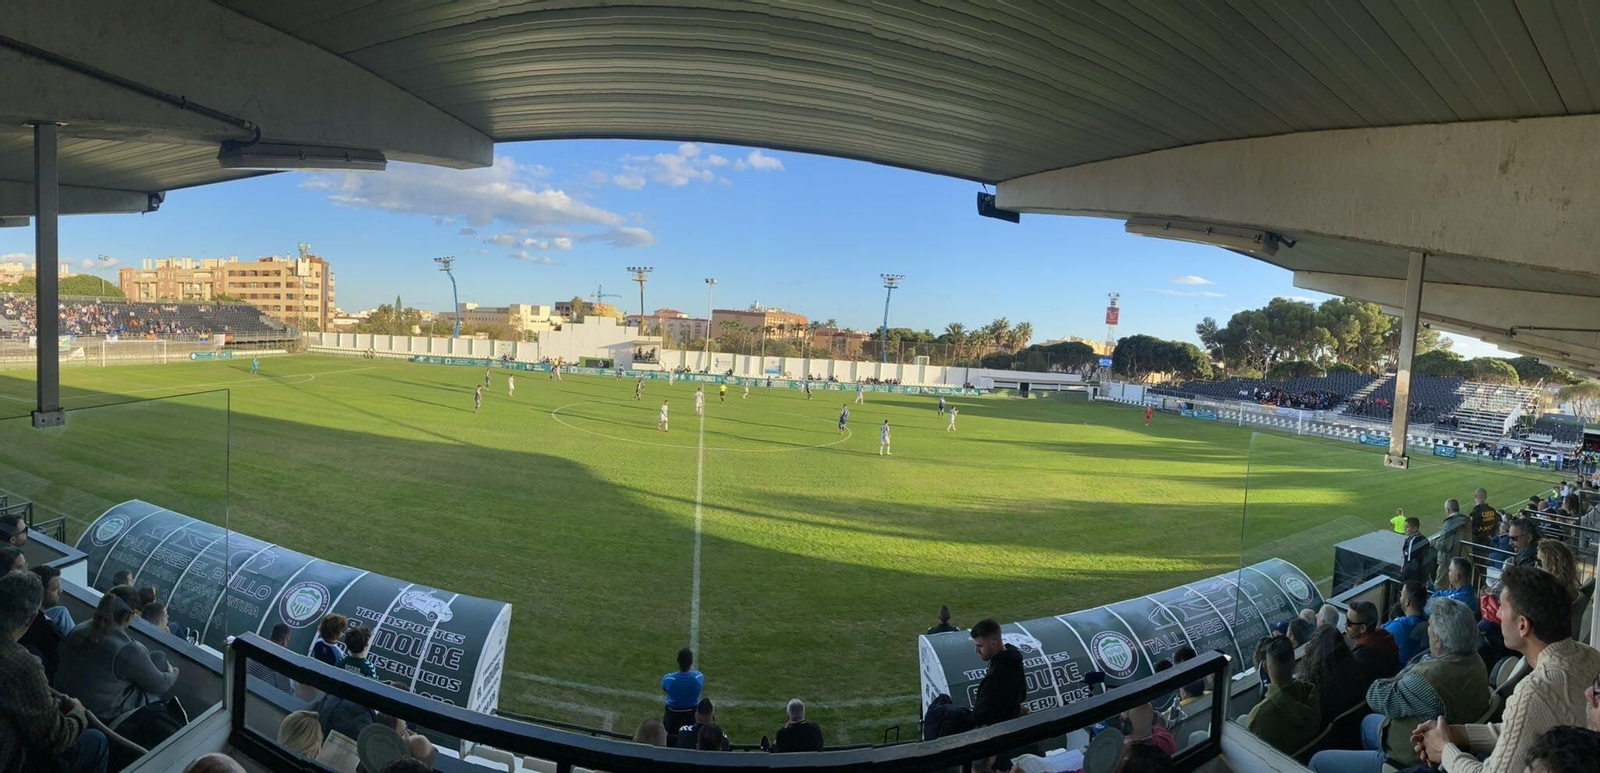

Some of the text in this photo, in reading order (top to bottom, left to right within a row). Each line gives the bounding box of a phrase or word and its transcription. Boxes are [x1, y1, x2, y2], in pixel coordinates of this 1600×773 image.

[121, 534, 191, 570] TALLERES
[189, 560, 208, 579] EL
[356, 606, 466, 645] TRANSPORTES
[1143, 617, 1226, 655] TALLERES
[1024, 662, 1082, 693] OURE
